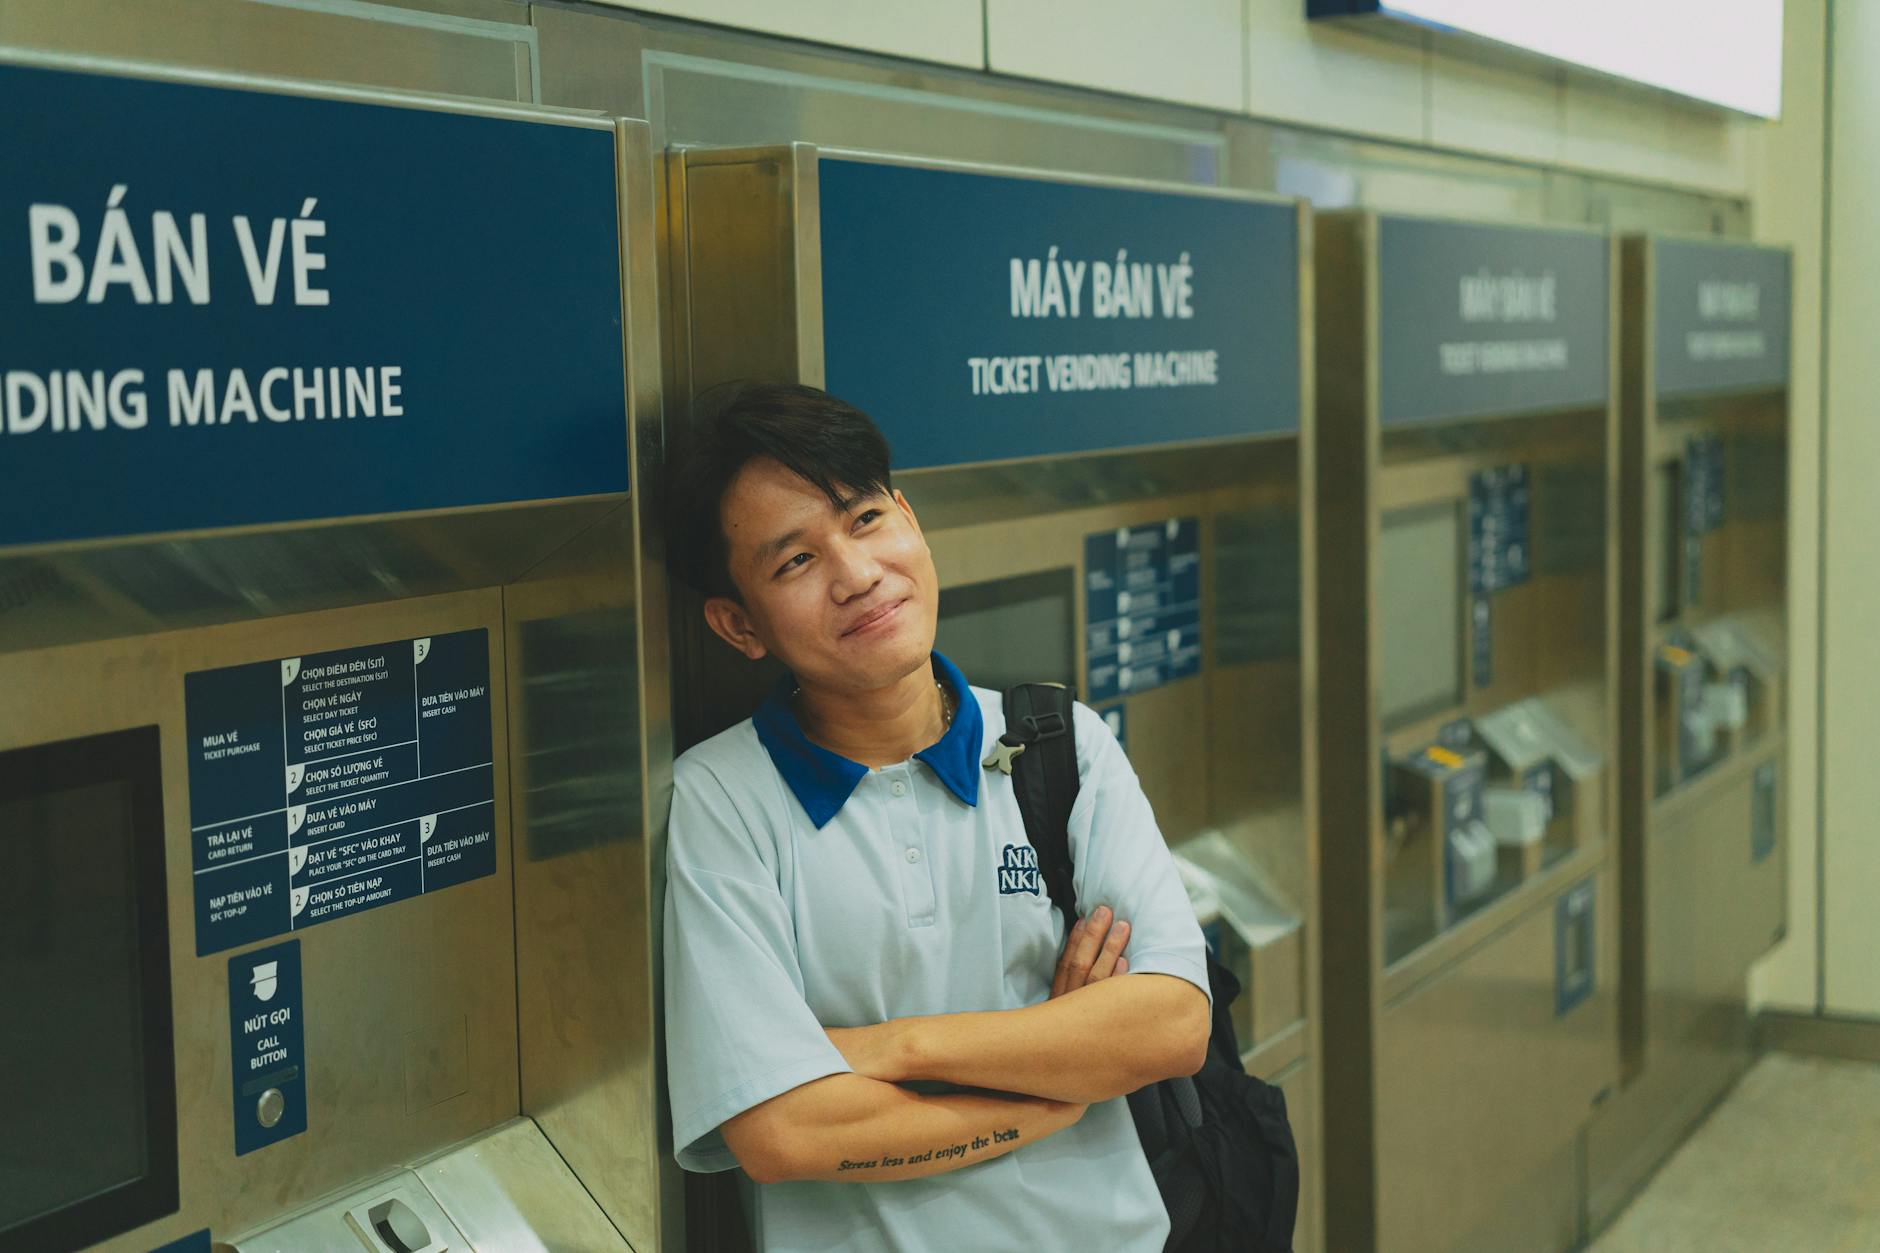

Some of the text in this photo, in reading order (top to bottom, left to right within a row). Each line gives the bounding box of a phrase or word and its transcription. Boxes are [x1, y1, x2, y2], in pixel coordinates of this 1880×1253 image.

[28, 184, 330, 306] BÁN VÉ
[1010, 245, 1194, 319] MÁY BÁN VÉ
[967, 350, 1218, 395] TICKET VENDING MACHINE
[0, 366, 404, 434] DING MACHINE
[419, 645, 423, 656] 3
[286, 666, 291, 677] 1
[302, 667, 324, 680] CHỌN
[368, 656, 384, 669] (SJT)
[302, 682, 322, 692] SELECT
[324, 681, 335, 689] THE
[337, 674, 374, 686] DESTINATION
[303, 698, 326, 710] CHỌN
[423, 706, 456, 718] INSERT CASH
[303, 706, 358, 723] SELECT DAY TICKET
[304, 728, 327, 741] CHỌN
[345, 721, 354, 733] VÉ
[358, 717, 376, 730] (SFC)
[203, 734, 225, 748] MUA
[304, 732, 377, 754] SELECT TICKET PRICE (SFC)
[204, 743, 260, 760] TICKET PURCHASE
[291, 772, 296, 784] 2
[306, 770, 329, 782] CHỌN
[373, 757, 383, 768] VÉ
[306, 771, 389, 796] SELECT THE TICKET QUANTITY
[292, 814, 297, 824] 1
[328, 808, 337, 819] VÉ
[307, 821, 345, 836] INSERT CARD
[425, 823, 430, 833] 3
[208, 843, 252, 860] CARD RETURN
[327, 848, 337, 860] VÉ
[380, 833, 401, 846] KHAY
[294, 855, 299, 866] 1
[309, 867, 325, 877] PLACE
[327, 862, 342, 872] YOUR
[367, 853, 376, 861] THE
[378, 849, 392, 859] CARD
[393, 846, 406, 855] TRAY
[428, 853, 461, 868] INSERT CASH
[296, 895, 301, 907] 2
[310, 891, 333, 905] CHỌN
[310, 889, 392, 918] SELECT THE TOP-UP AMOUNT
[210, 906, 247, 922] SFC TOP-UP
[244, 1008, 290, 1034] NÚT GỌI
[258, 1035, 279, 1051] CALL
[251, 1048, 287, 1070] BUTTON
[838, 1160, 877, 1171] Stress
[881, 1156, 904, 1167] less
[908, 1150, 932, 1163] and
[935, 1143, 968, 1160] enjoy
[971, 1136, 990, 1150] the
